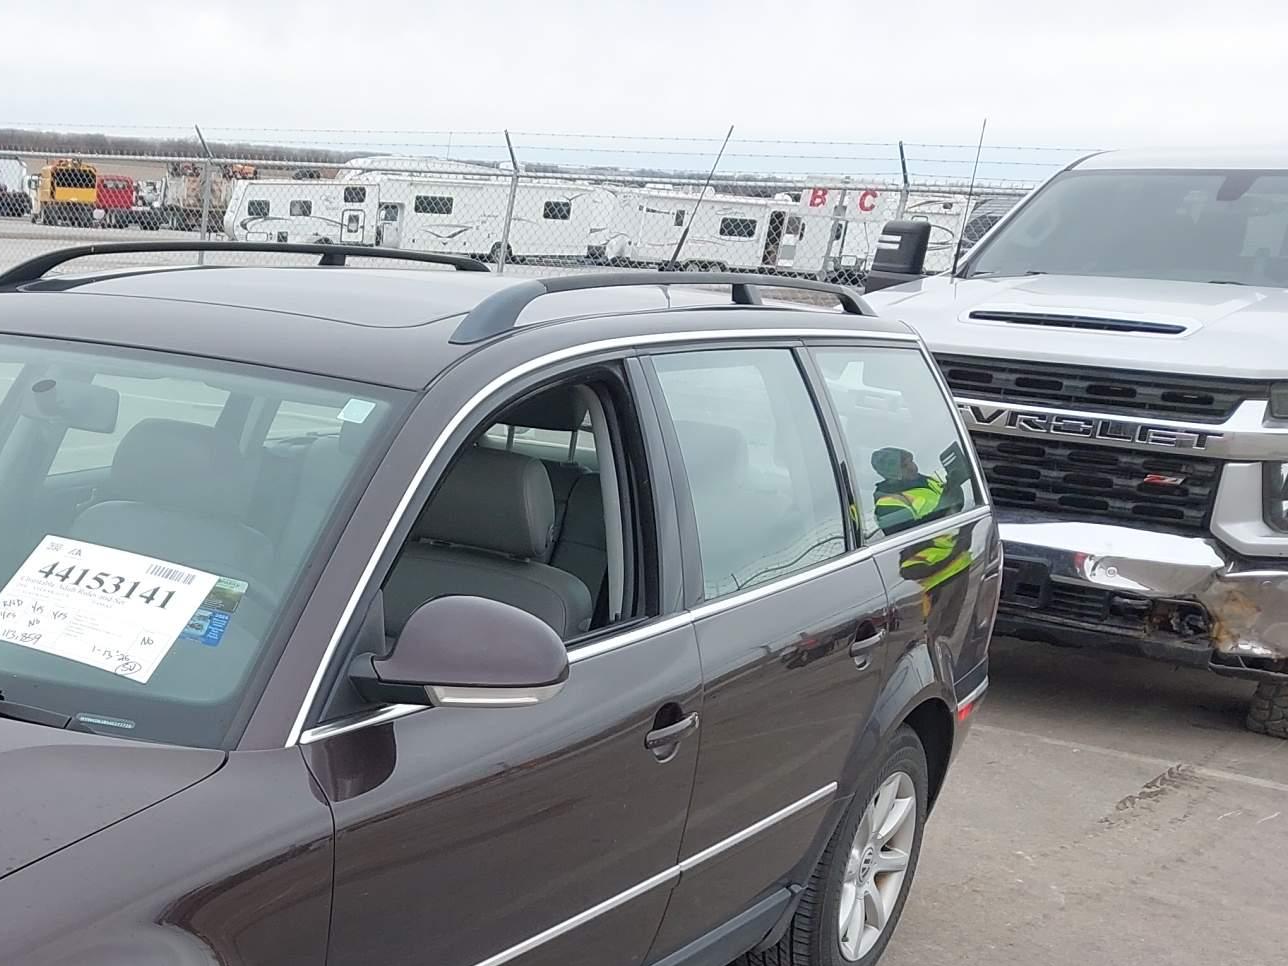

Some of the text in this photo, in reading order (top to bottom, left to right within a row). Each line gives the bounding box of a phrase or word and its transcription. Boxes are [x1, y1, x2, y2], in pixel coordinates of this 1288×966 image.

[810, 188, 828, 207] B
[859, 190, 878, 212] C
[958, 405, 1224, 450] VROLET
[38, 561, 177, 610] 44153141
